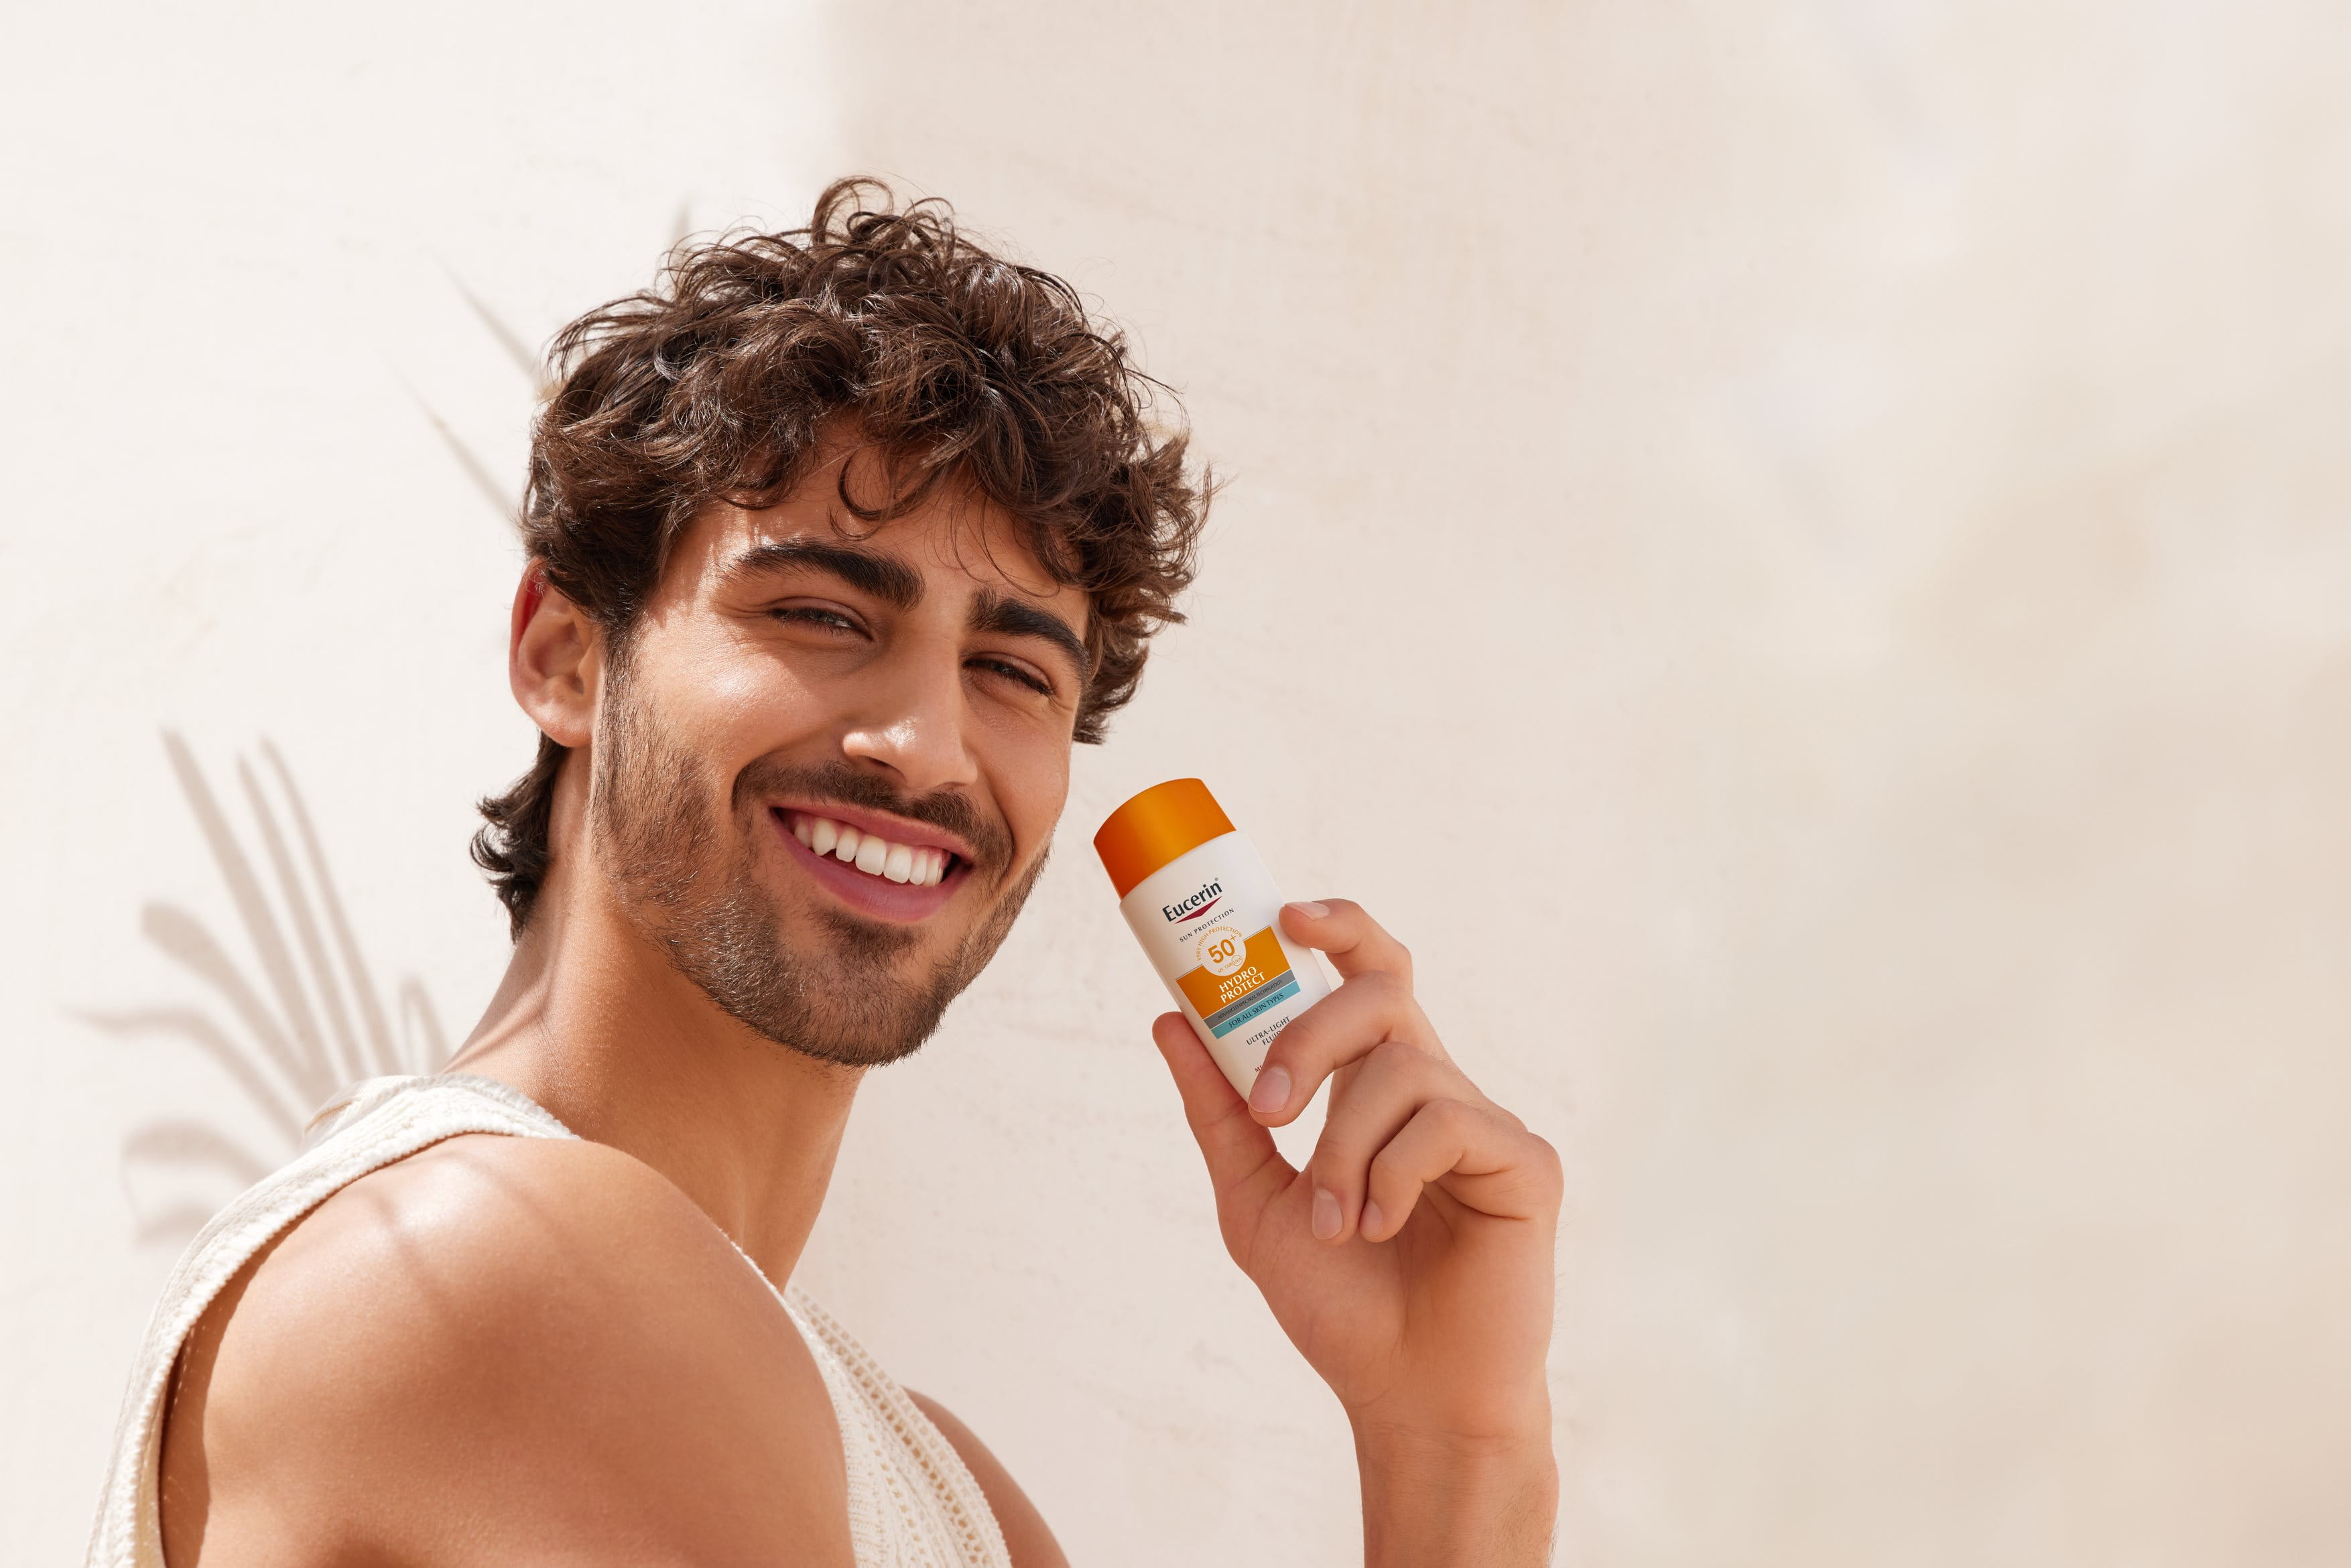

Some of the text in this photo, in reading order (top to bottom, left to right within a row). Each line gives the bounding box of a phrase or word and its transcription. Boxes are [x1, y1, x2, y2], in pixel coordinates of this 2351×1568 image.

[1162, 882, 1222, 922] Eucerin
[1179, 908, 1234, 943] SUN PROTECTION
[1198, 933, 1209, 946] HIGH
[1208, 926, 1243, 937] PROTECTION
[1219, 966, 1257, 992] HYDRO
[1220, 972, 1265, 1003] PROTECT
[1218, 980, 1283, 1019] ADVANCED SPECTRAL TECHNOLOGY
[1228, 992, 1284, 1028] FOR ALL SKIN TYPES
[1247, 1016, 1291, 1045] ULTRA-LIGHT
